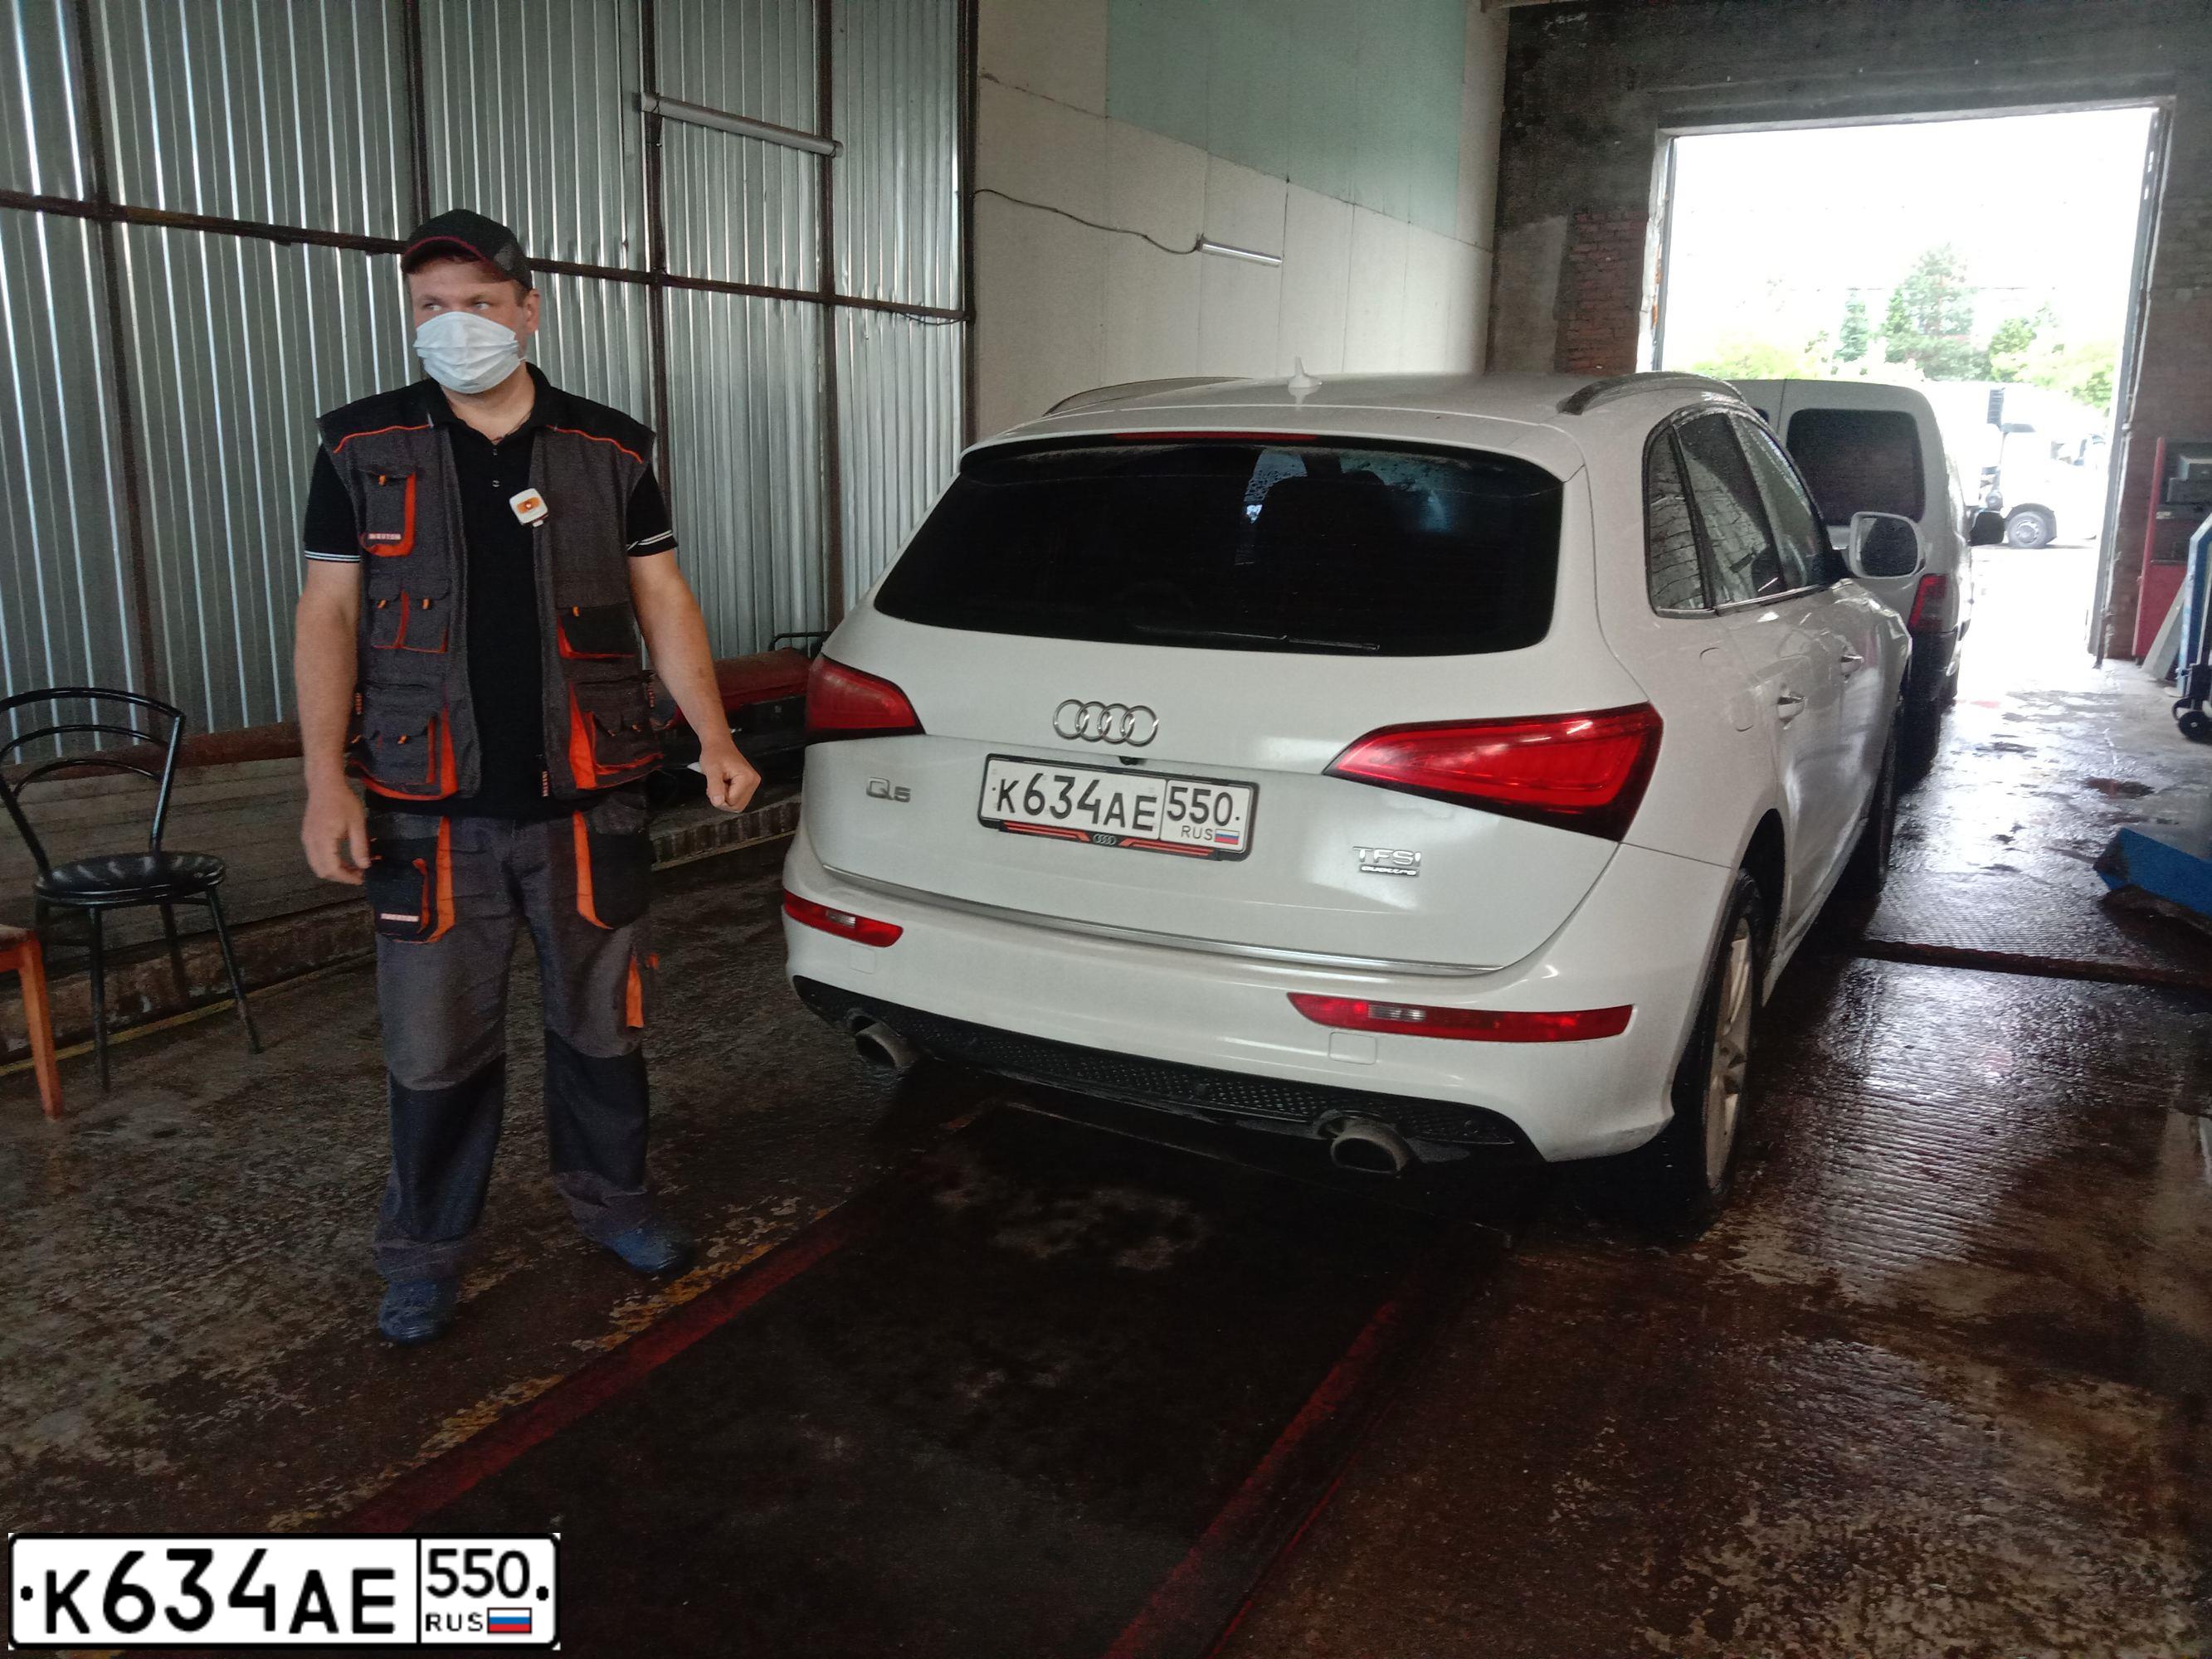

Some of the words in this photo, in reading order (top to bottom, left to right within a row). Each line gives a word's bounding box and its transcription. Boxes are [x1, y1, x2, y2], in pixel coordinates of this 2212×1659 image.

[866, 776, 911, 803] Q5
[1167, 786, 1233, 827] 550
[1181, 825, 1213, 841] RUS
[1352, 846, 1420, 867] TFSI
